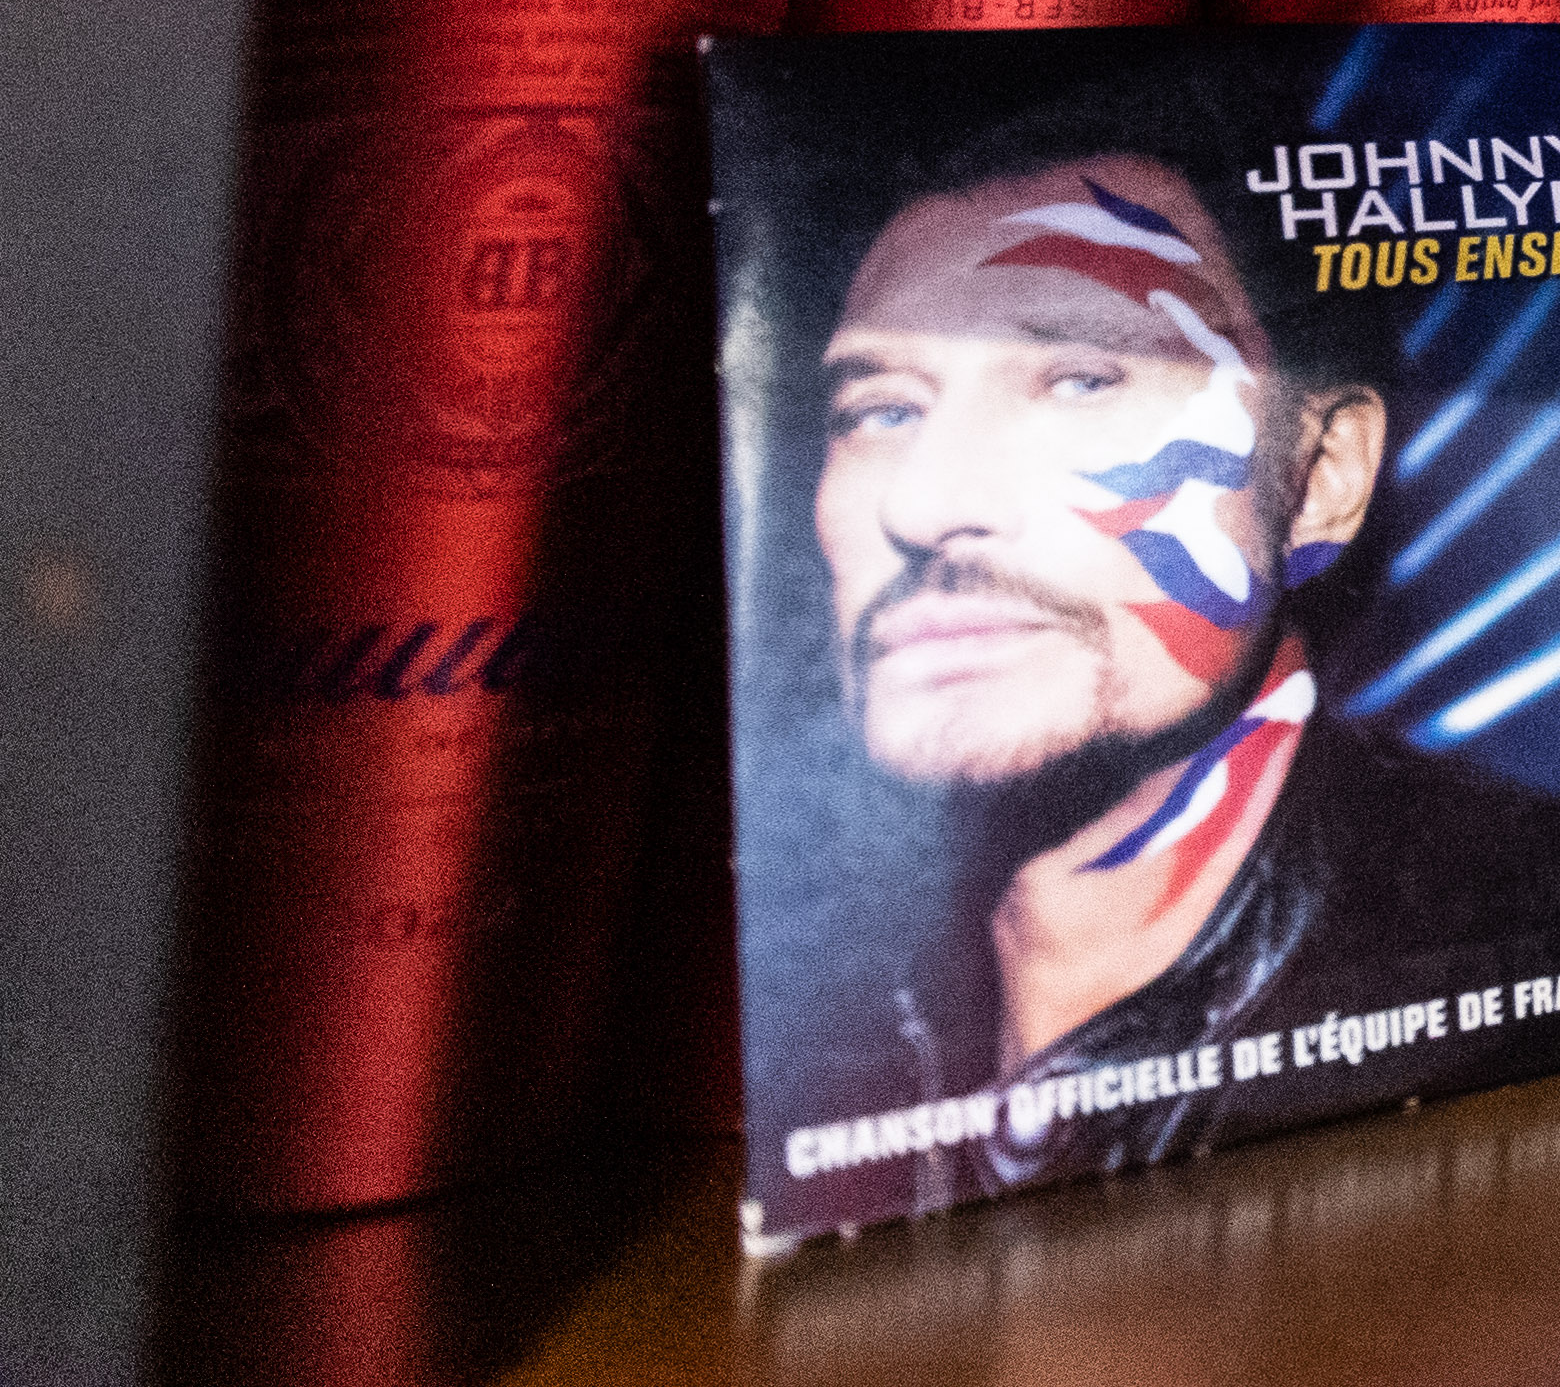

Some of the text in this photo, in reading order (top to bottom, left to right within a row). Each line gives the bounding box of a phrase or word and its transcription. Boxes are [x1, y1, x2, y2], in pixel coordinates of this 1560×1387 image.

[1313, 238, 1440, 292] TOUS
[785, 1092, 995, 1181] CHANSON
[1005, 1046, 1221, 1139] OFFICIELLE
[1234, 1038, 1284, 1081] DE
[1294, 998, 1449, 1068] L'ÉQUIPE
[1459, 986, 1505, 1031] DE
